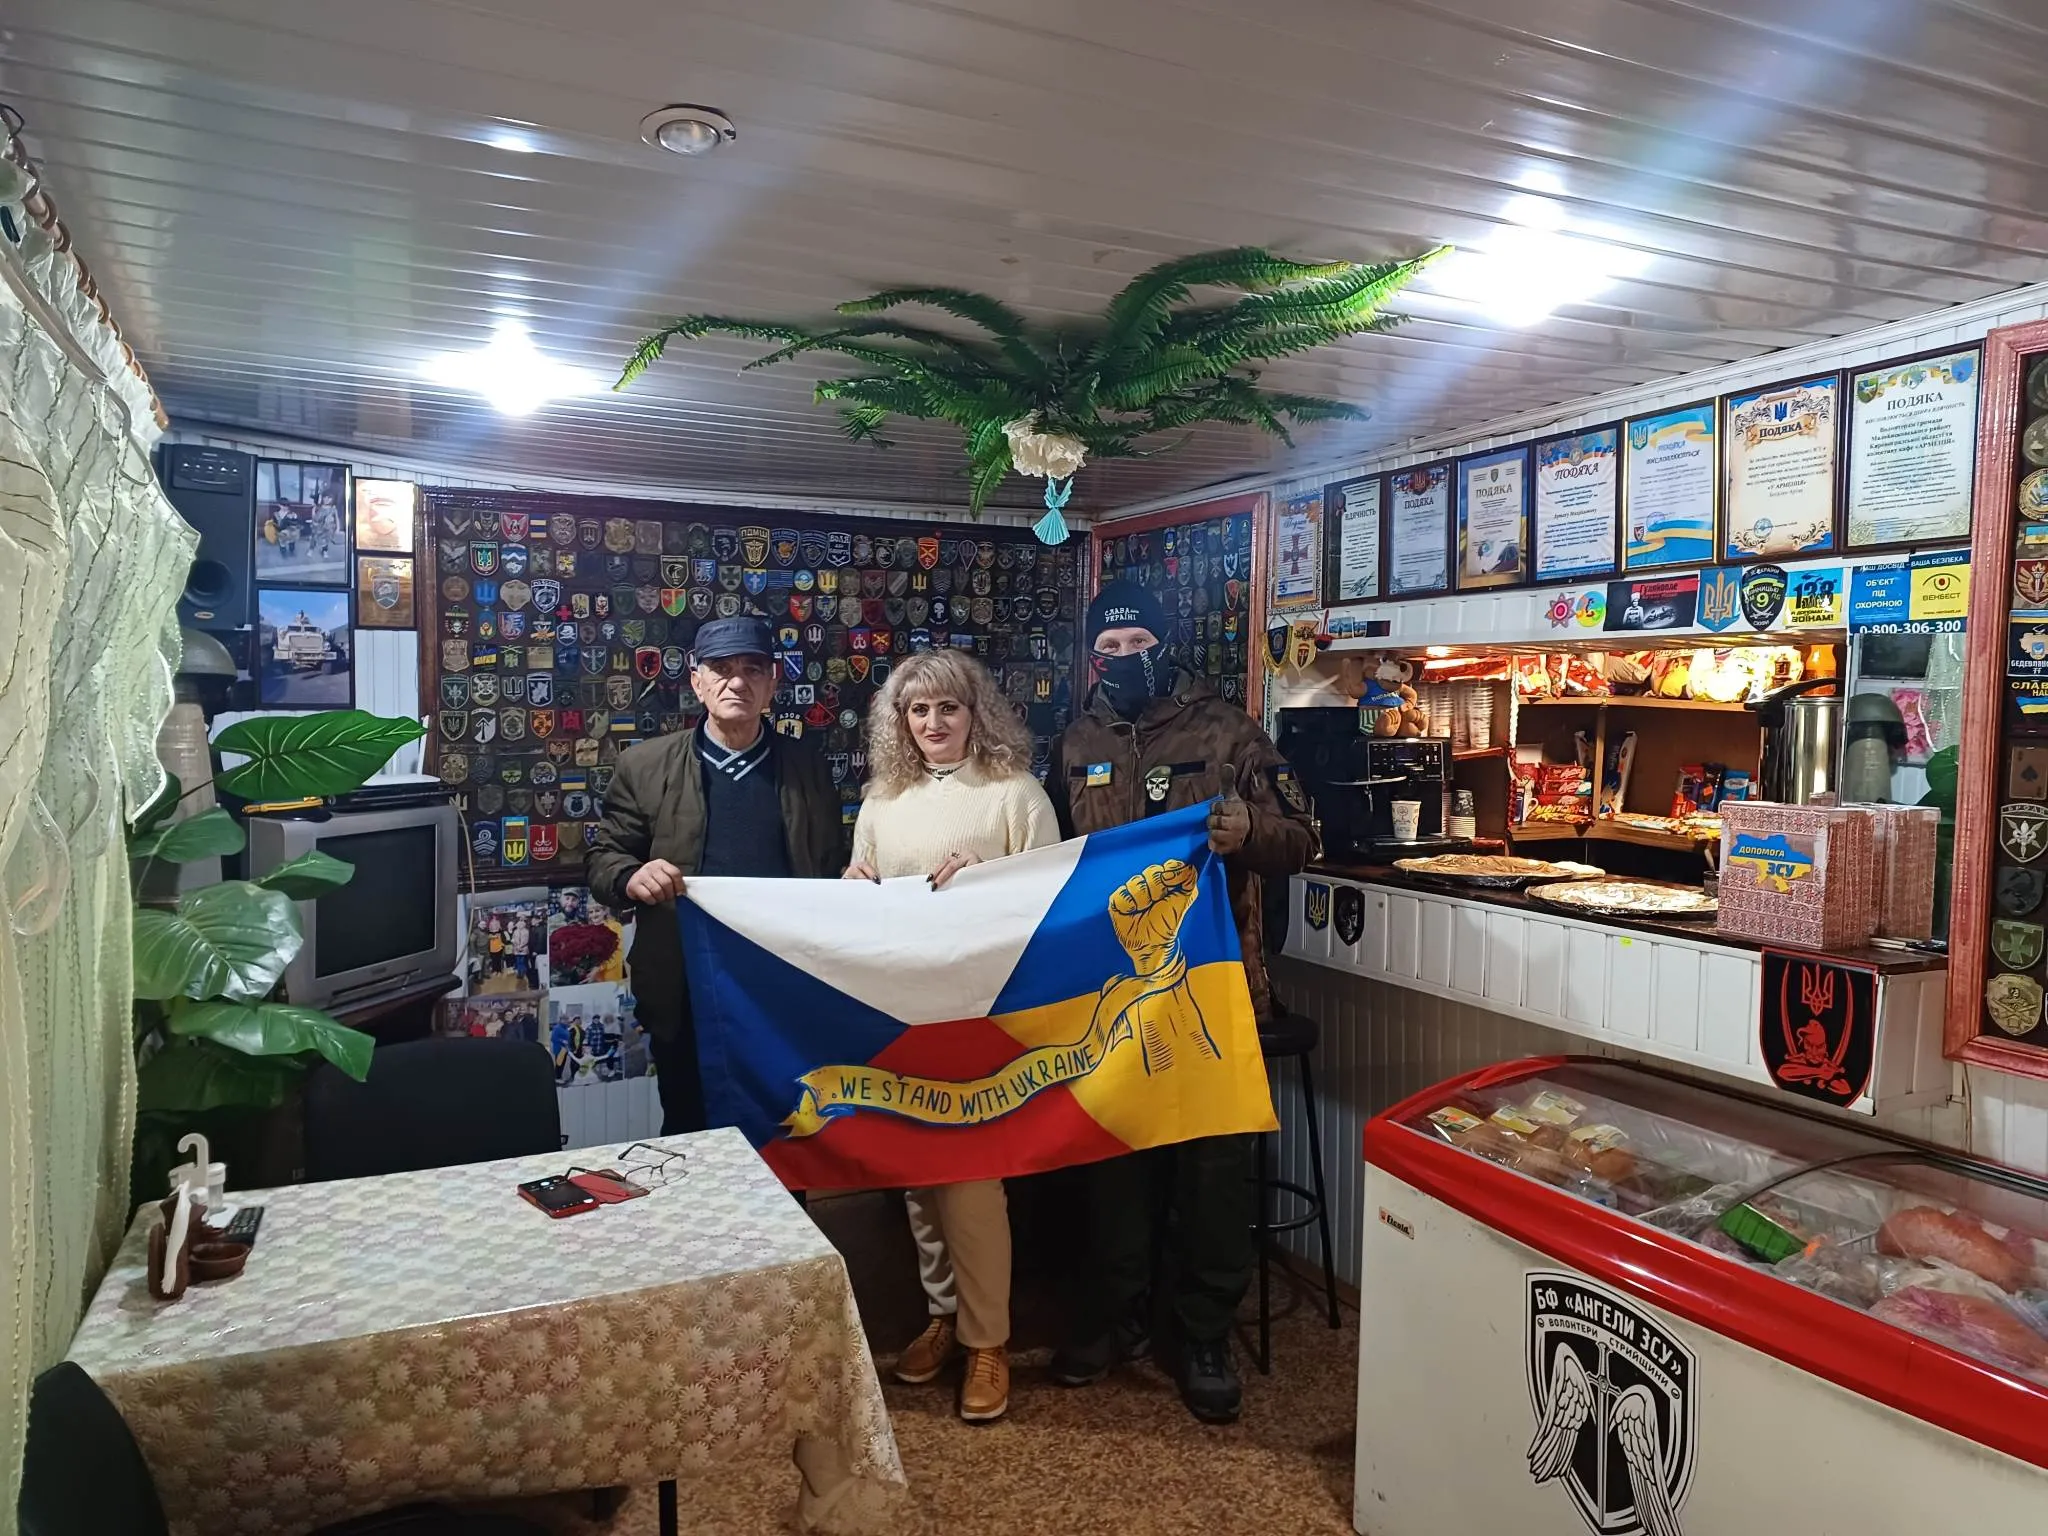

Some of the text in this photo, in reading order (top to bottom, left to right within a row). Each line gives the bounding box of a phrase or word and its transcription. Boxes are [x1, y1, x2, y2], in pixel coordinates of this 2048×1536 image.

[1887, 392, 1944, 410] ПОДЯКА
[1759, 421, 1803, 439] ПОДЯКА
[1554, 463, 1599, 480] ПОДЯКА
[1476, 483, 1513, 498] ПОДЯКА
[1404, 497, 1434, 509] ПОДЯКА
[1931, 556, 1963, 564] БЕЗПЕКА
[1756, 592, 1769, 608] 9
[1923, 593, 1961, 601] ВЕНБЕСТ
[1855, 600, 1903, 609] ОХОРОНОЮ
[1104, 608, 1130, 616] СЛАВА
[1105, 613, 1136, 623] УКРАЇНІ
[1792, 614, 1834, 623] ВОЇНАМ!
[1860, 620, 1961, 634] 0-800-306-300
[1739, 846, 1785, 858] ДОПОМОГА
[1767, 862, 1796, 877] ЗСУ
[840, 1044, 1096, 1117] WE STAND WITH UKRAINE
[1535, 1287, 1682, 1376] БФ «АНГЕЛИ ЗСУ»
[1548, 1317, 1669, 1387] ВОЛОНТЕРИ СТРИЙЩИНИ
